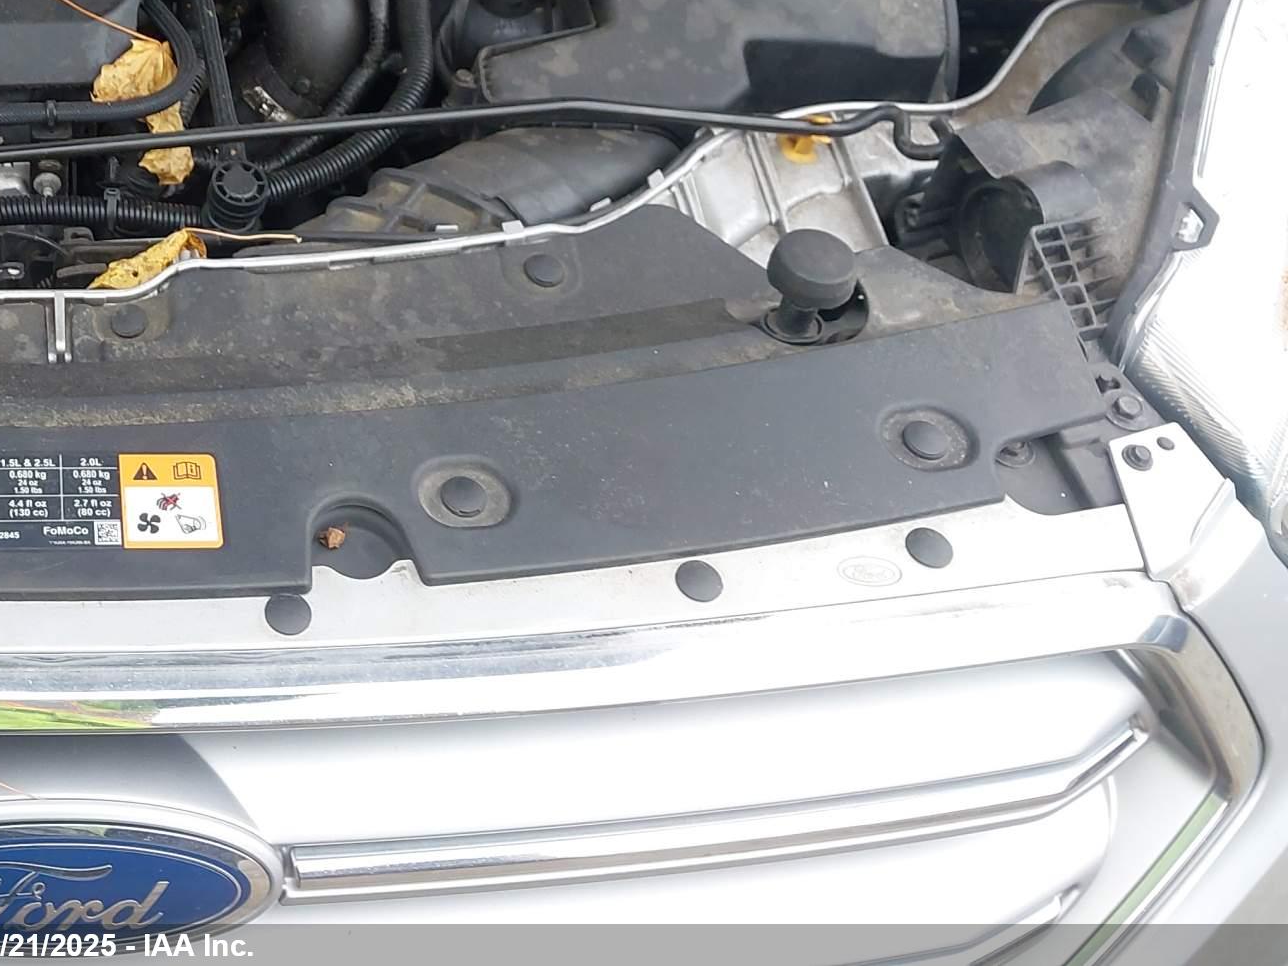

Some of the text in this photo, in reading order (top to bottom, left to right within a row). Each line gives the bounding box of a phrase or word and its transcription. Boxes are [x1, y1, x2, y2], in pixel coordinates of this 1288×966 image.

[0, 458, 56, 467] 1.5L & 2.5L
[80, 458, 102, 467] 2.0L
[34, 470, 47, 480] kg
[98, 470, 111, 480] kg
[25, 499, 33, 507] fl
[73, 499, 88, 507] 2.7
[90, 499, 98, 507] fl
[9, 508, 48, 518] (130 cc)
[77, 508, 111, 518] (80 cc)
[43, 525, 89, 535] FoMoCo
